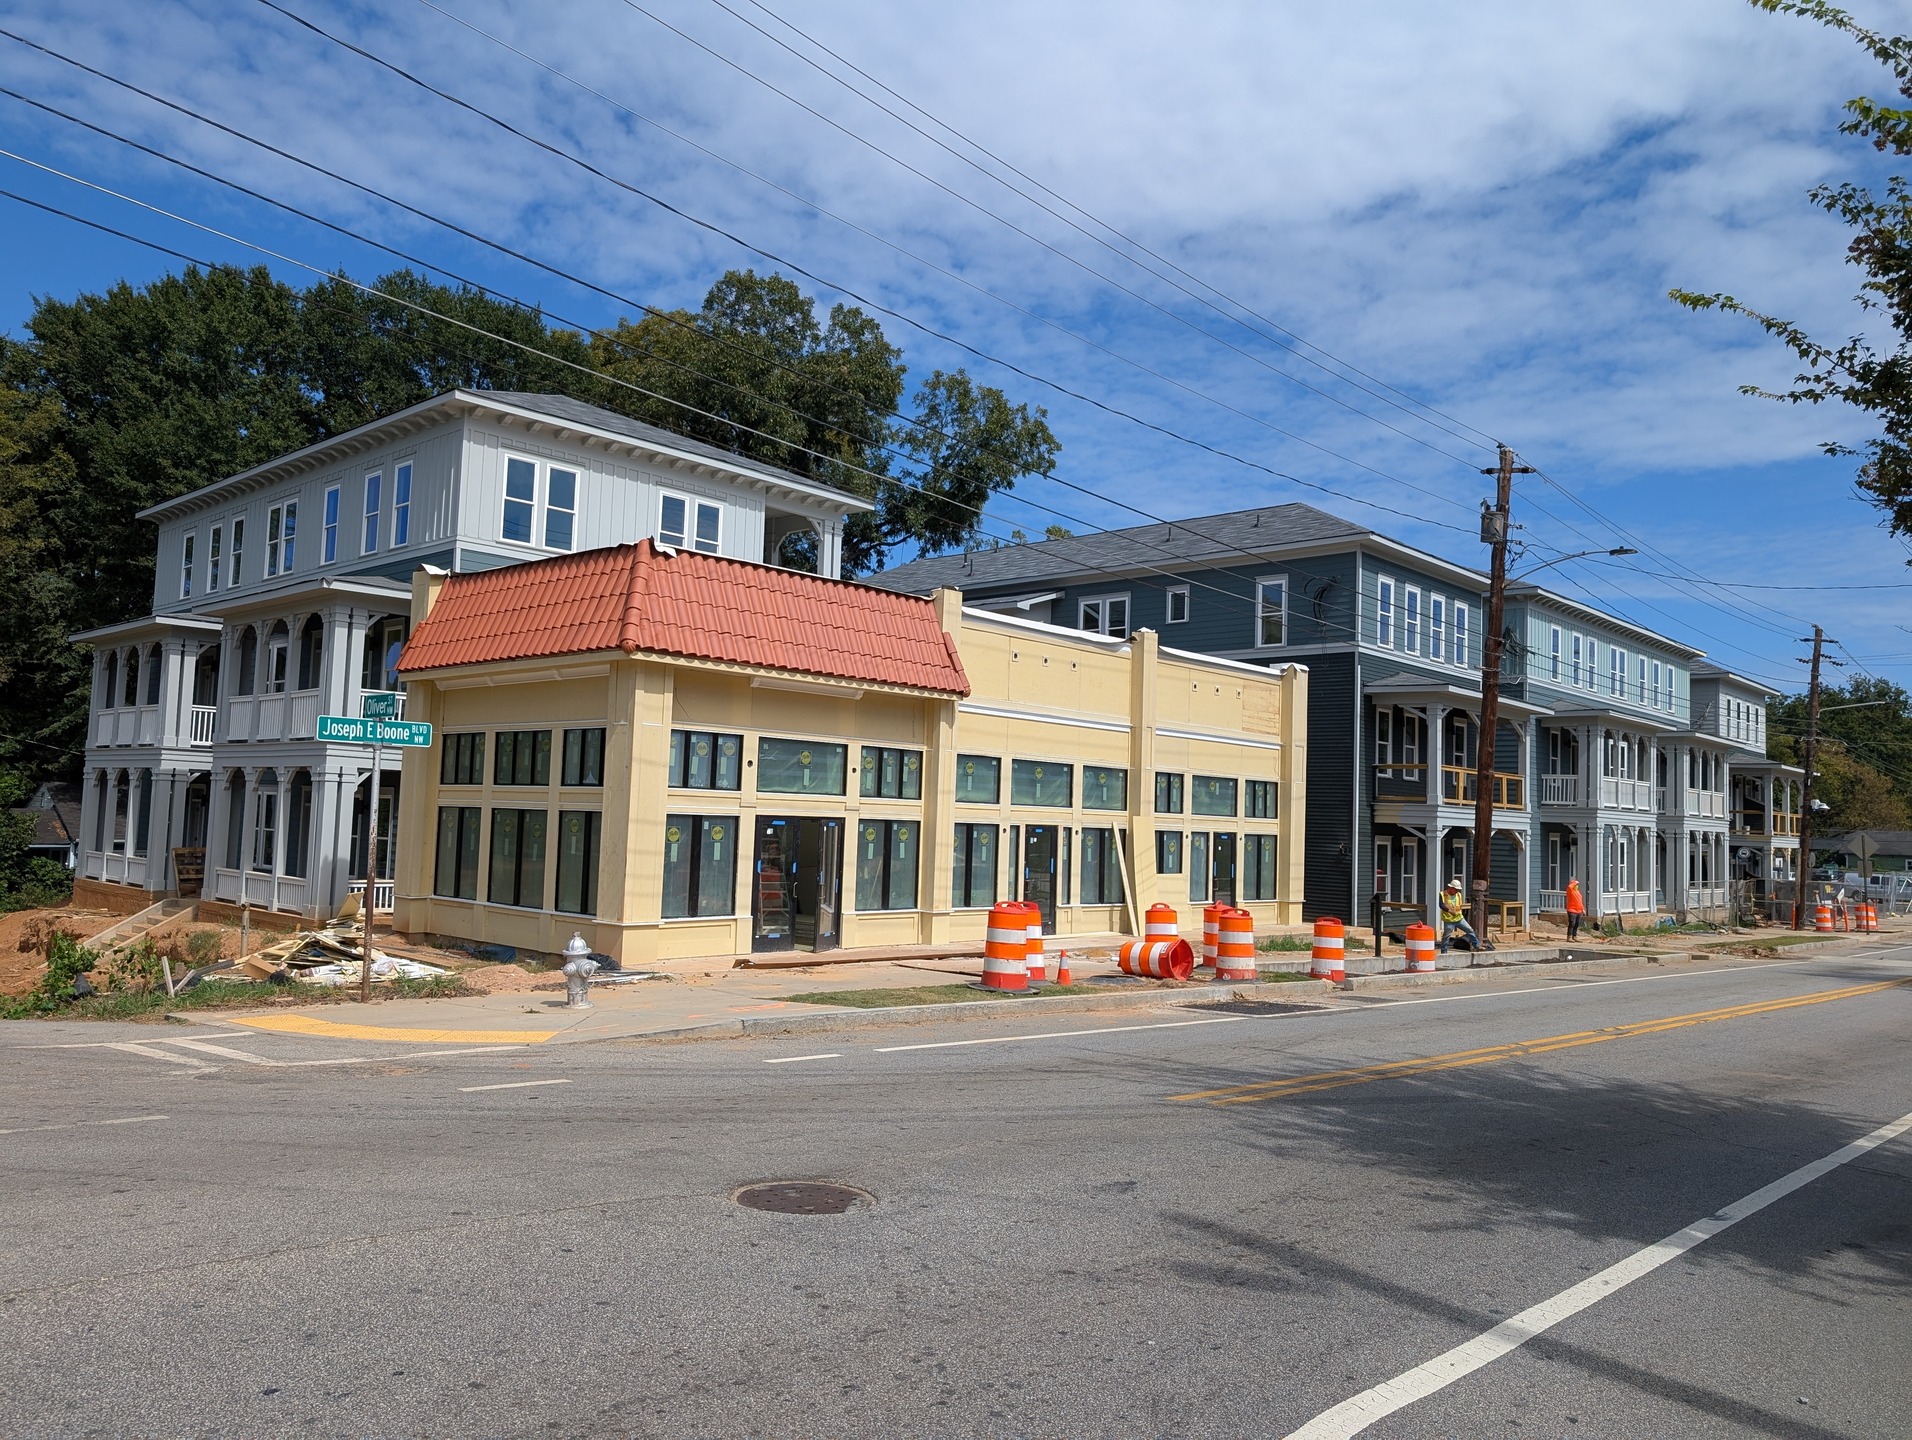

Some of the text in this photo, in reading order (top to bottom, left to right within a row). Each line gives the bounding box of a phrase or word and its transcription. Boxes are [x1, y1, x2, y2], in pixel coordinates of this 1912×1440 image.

[388, 696, 393, 704] ST
[367, 699, 387, 714] Oliver
[387, 706, 393, 714] NW
[322, 719, 410, 740] Joseph E Boone
[412, 725, 428, 733] BLVD
